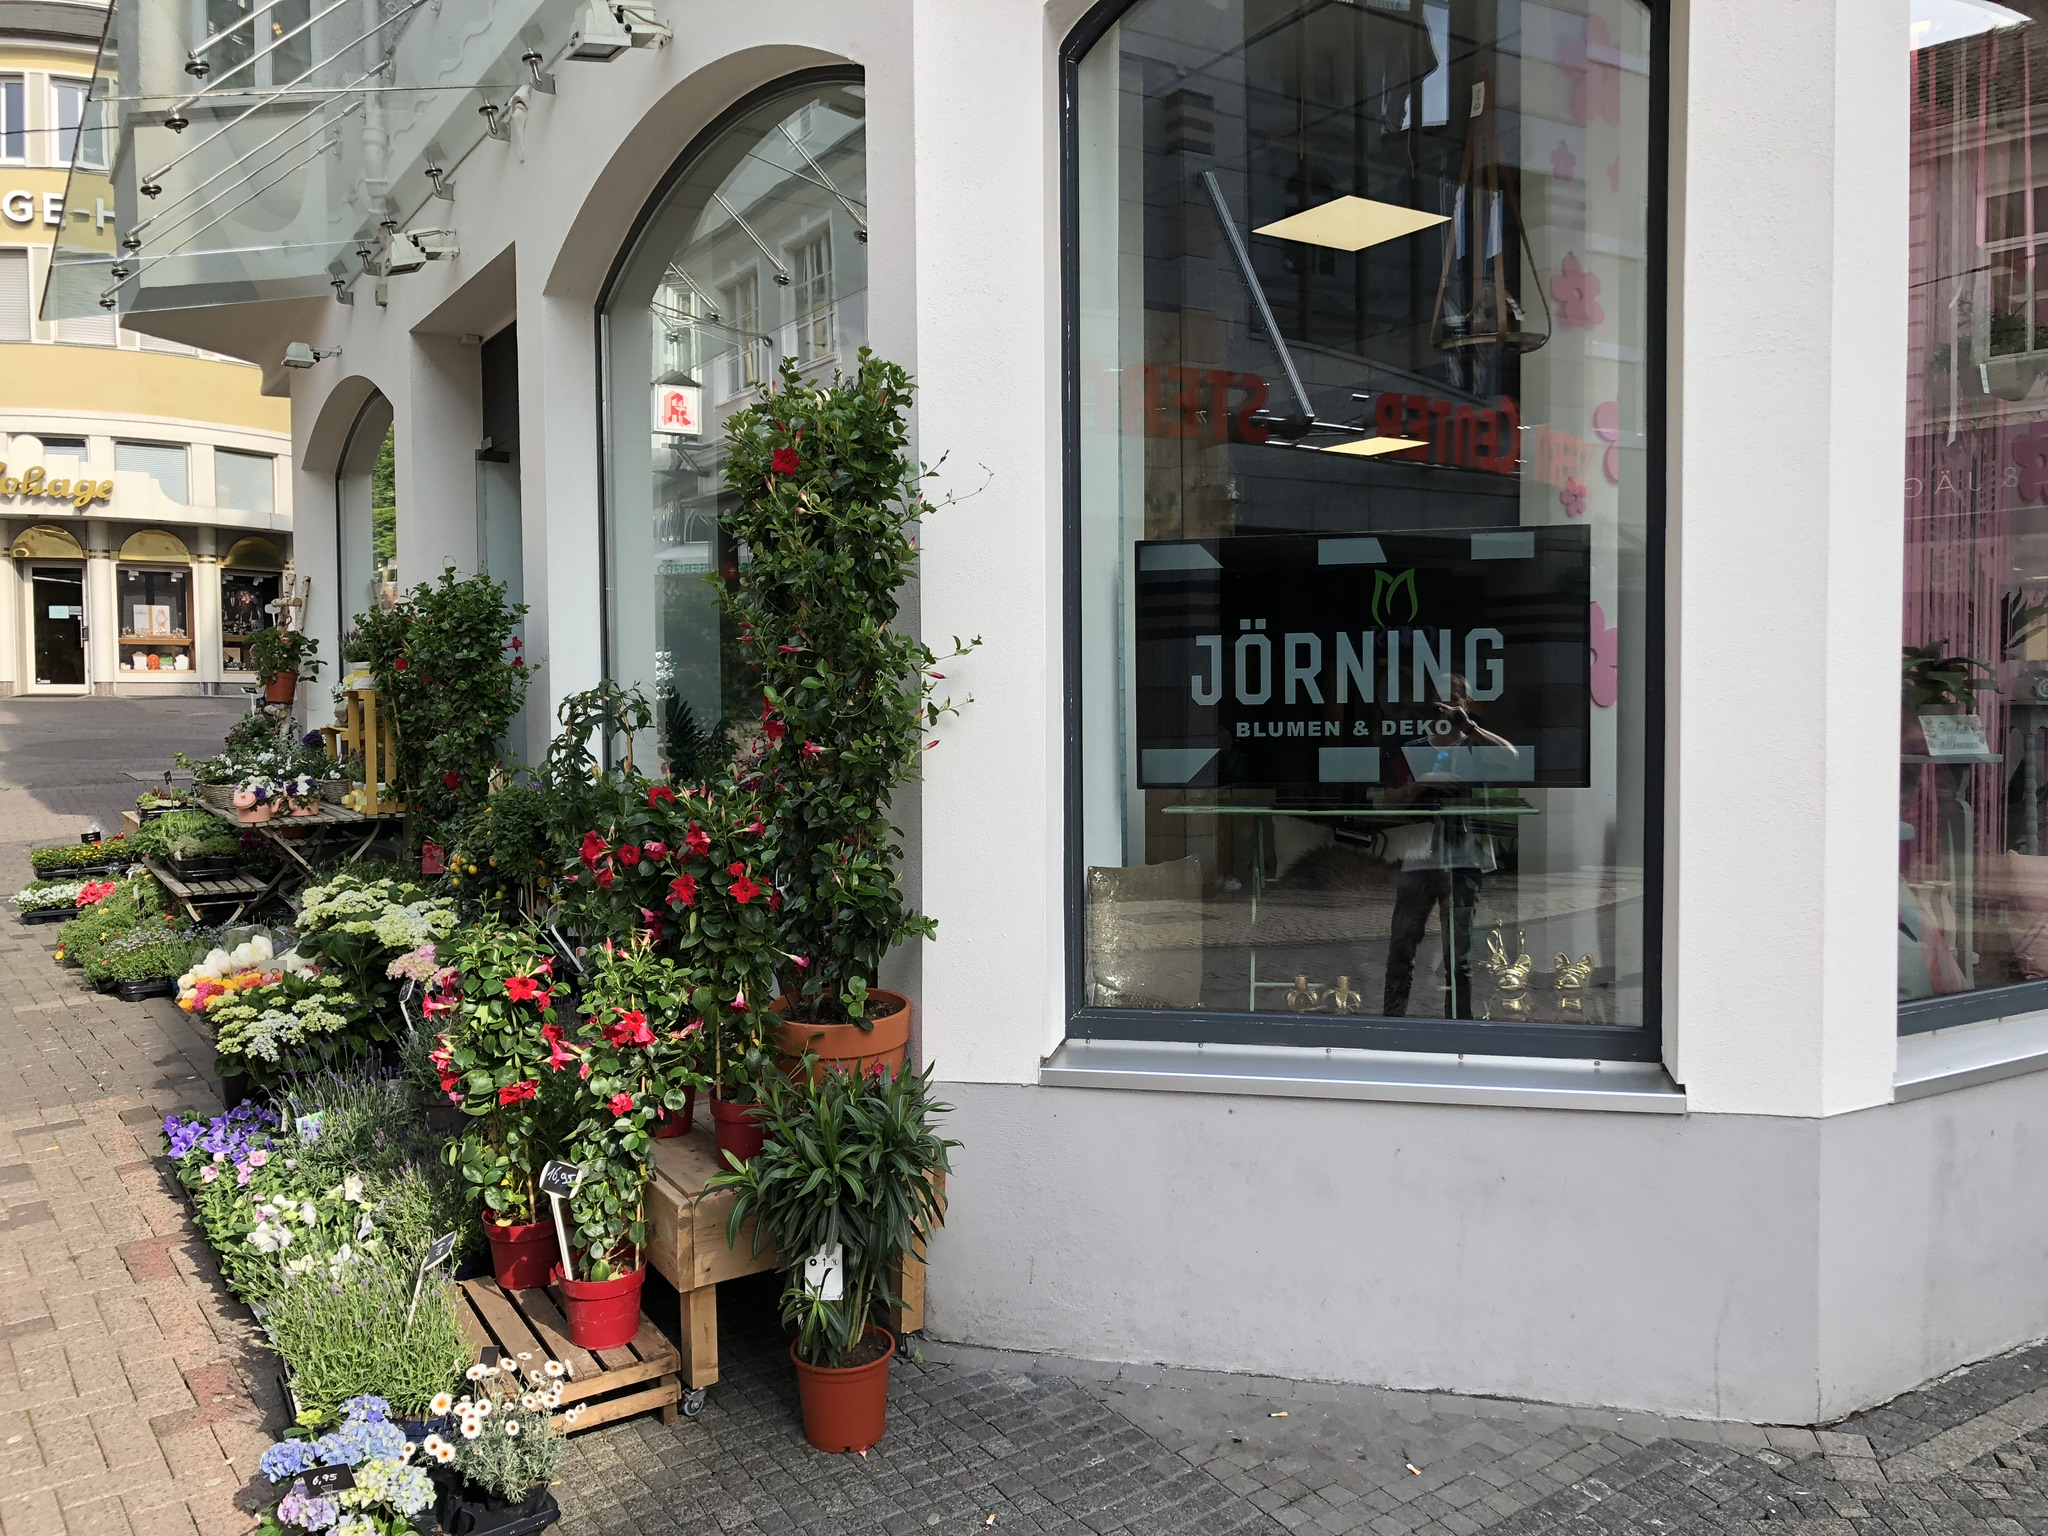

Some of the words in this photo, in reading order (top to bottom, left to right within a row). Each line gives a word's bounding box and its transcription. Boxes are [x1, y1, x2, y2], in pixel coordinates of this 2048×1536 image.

[1191, 618, 1504, 706] JÖRNING
[1236, 720, 1340, 737] BLUMEN
[1353, 720, 1369, 736] &
[1381, 719, 1452, 736] DEKO
[547, 1166, 577, 1185] 16,95
[312, 1473, 338, 1486] 6,95
